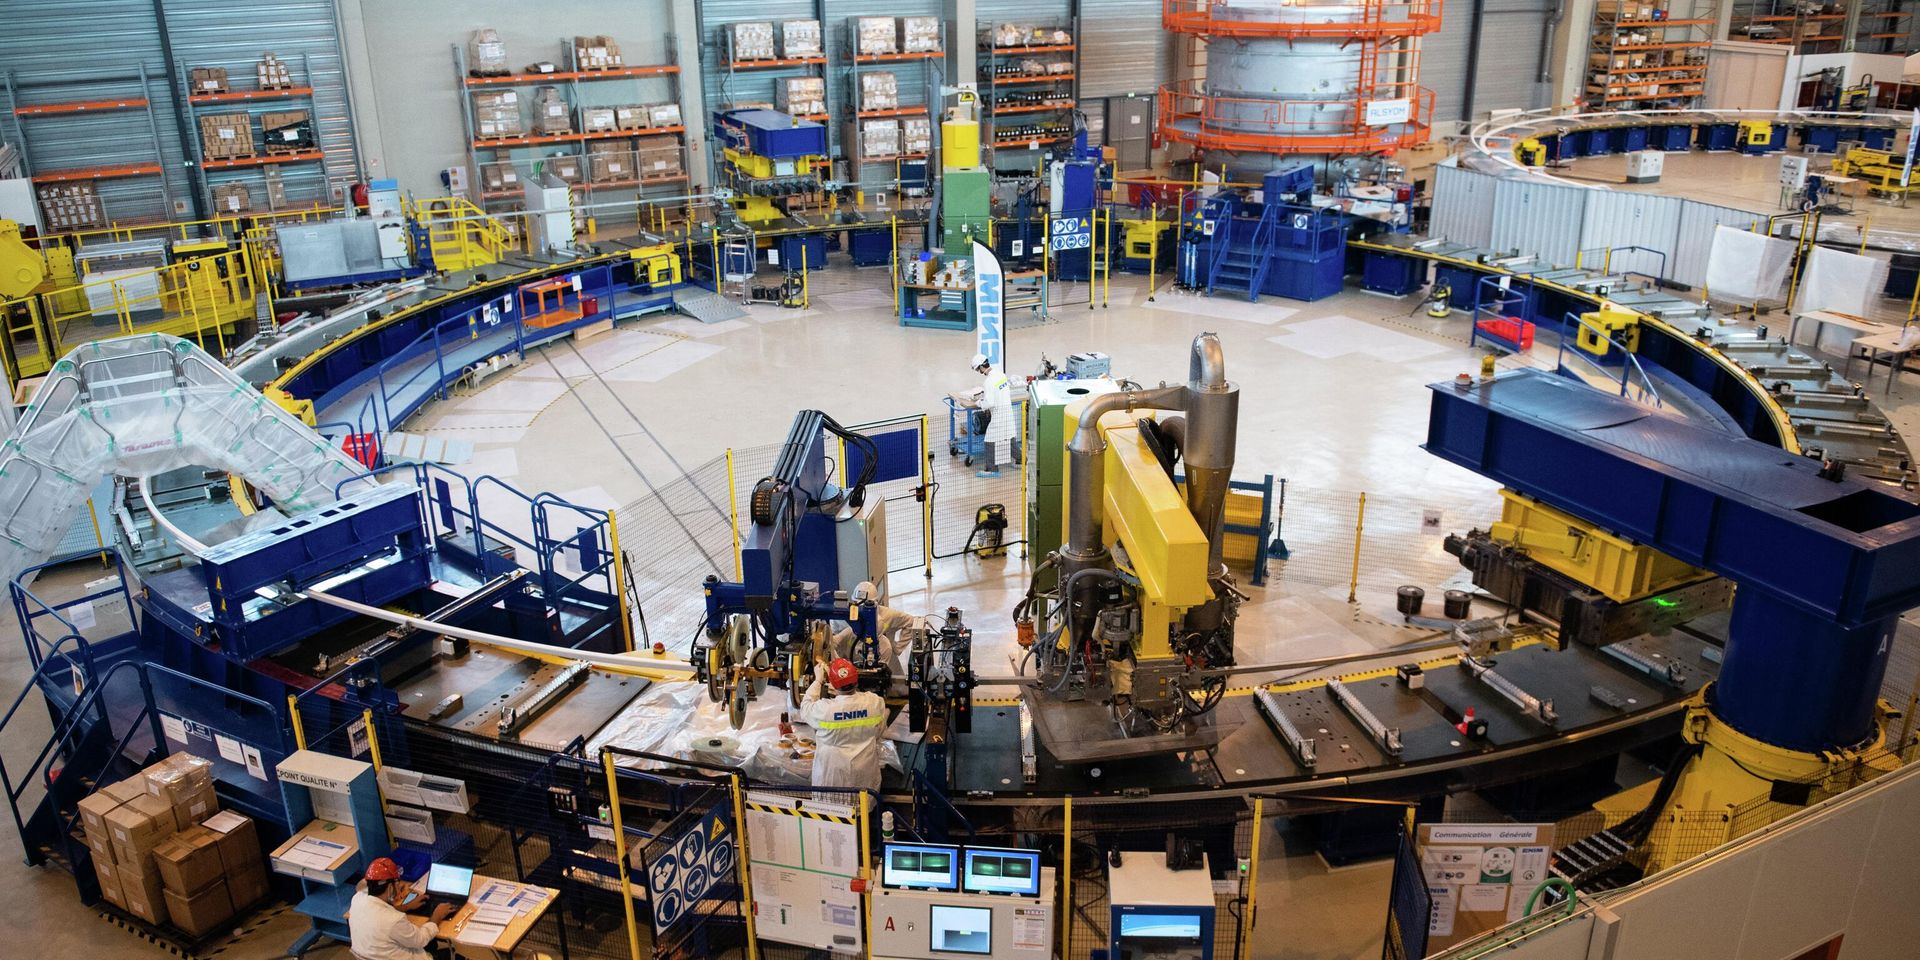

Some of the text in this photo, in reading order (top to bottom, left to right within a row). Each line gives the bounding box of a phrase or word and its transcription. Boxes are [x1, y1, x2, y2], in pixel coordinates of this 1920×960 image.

[1877, 634, 1888, 656] A
[833, 709, 868, 721] CNIM
[280, 771, 298, 780] POINT
[884, 916, 895, 931] A
